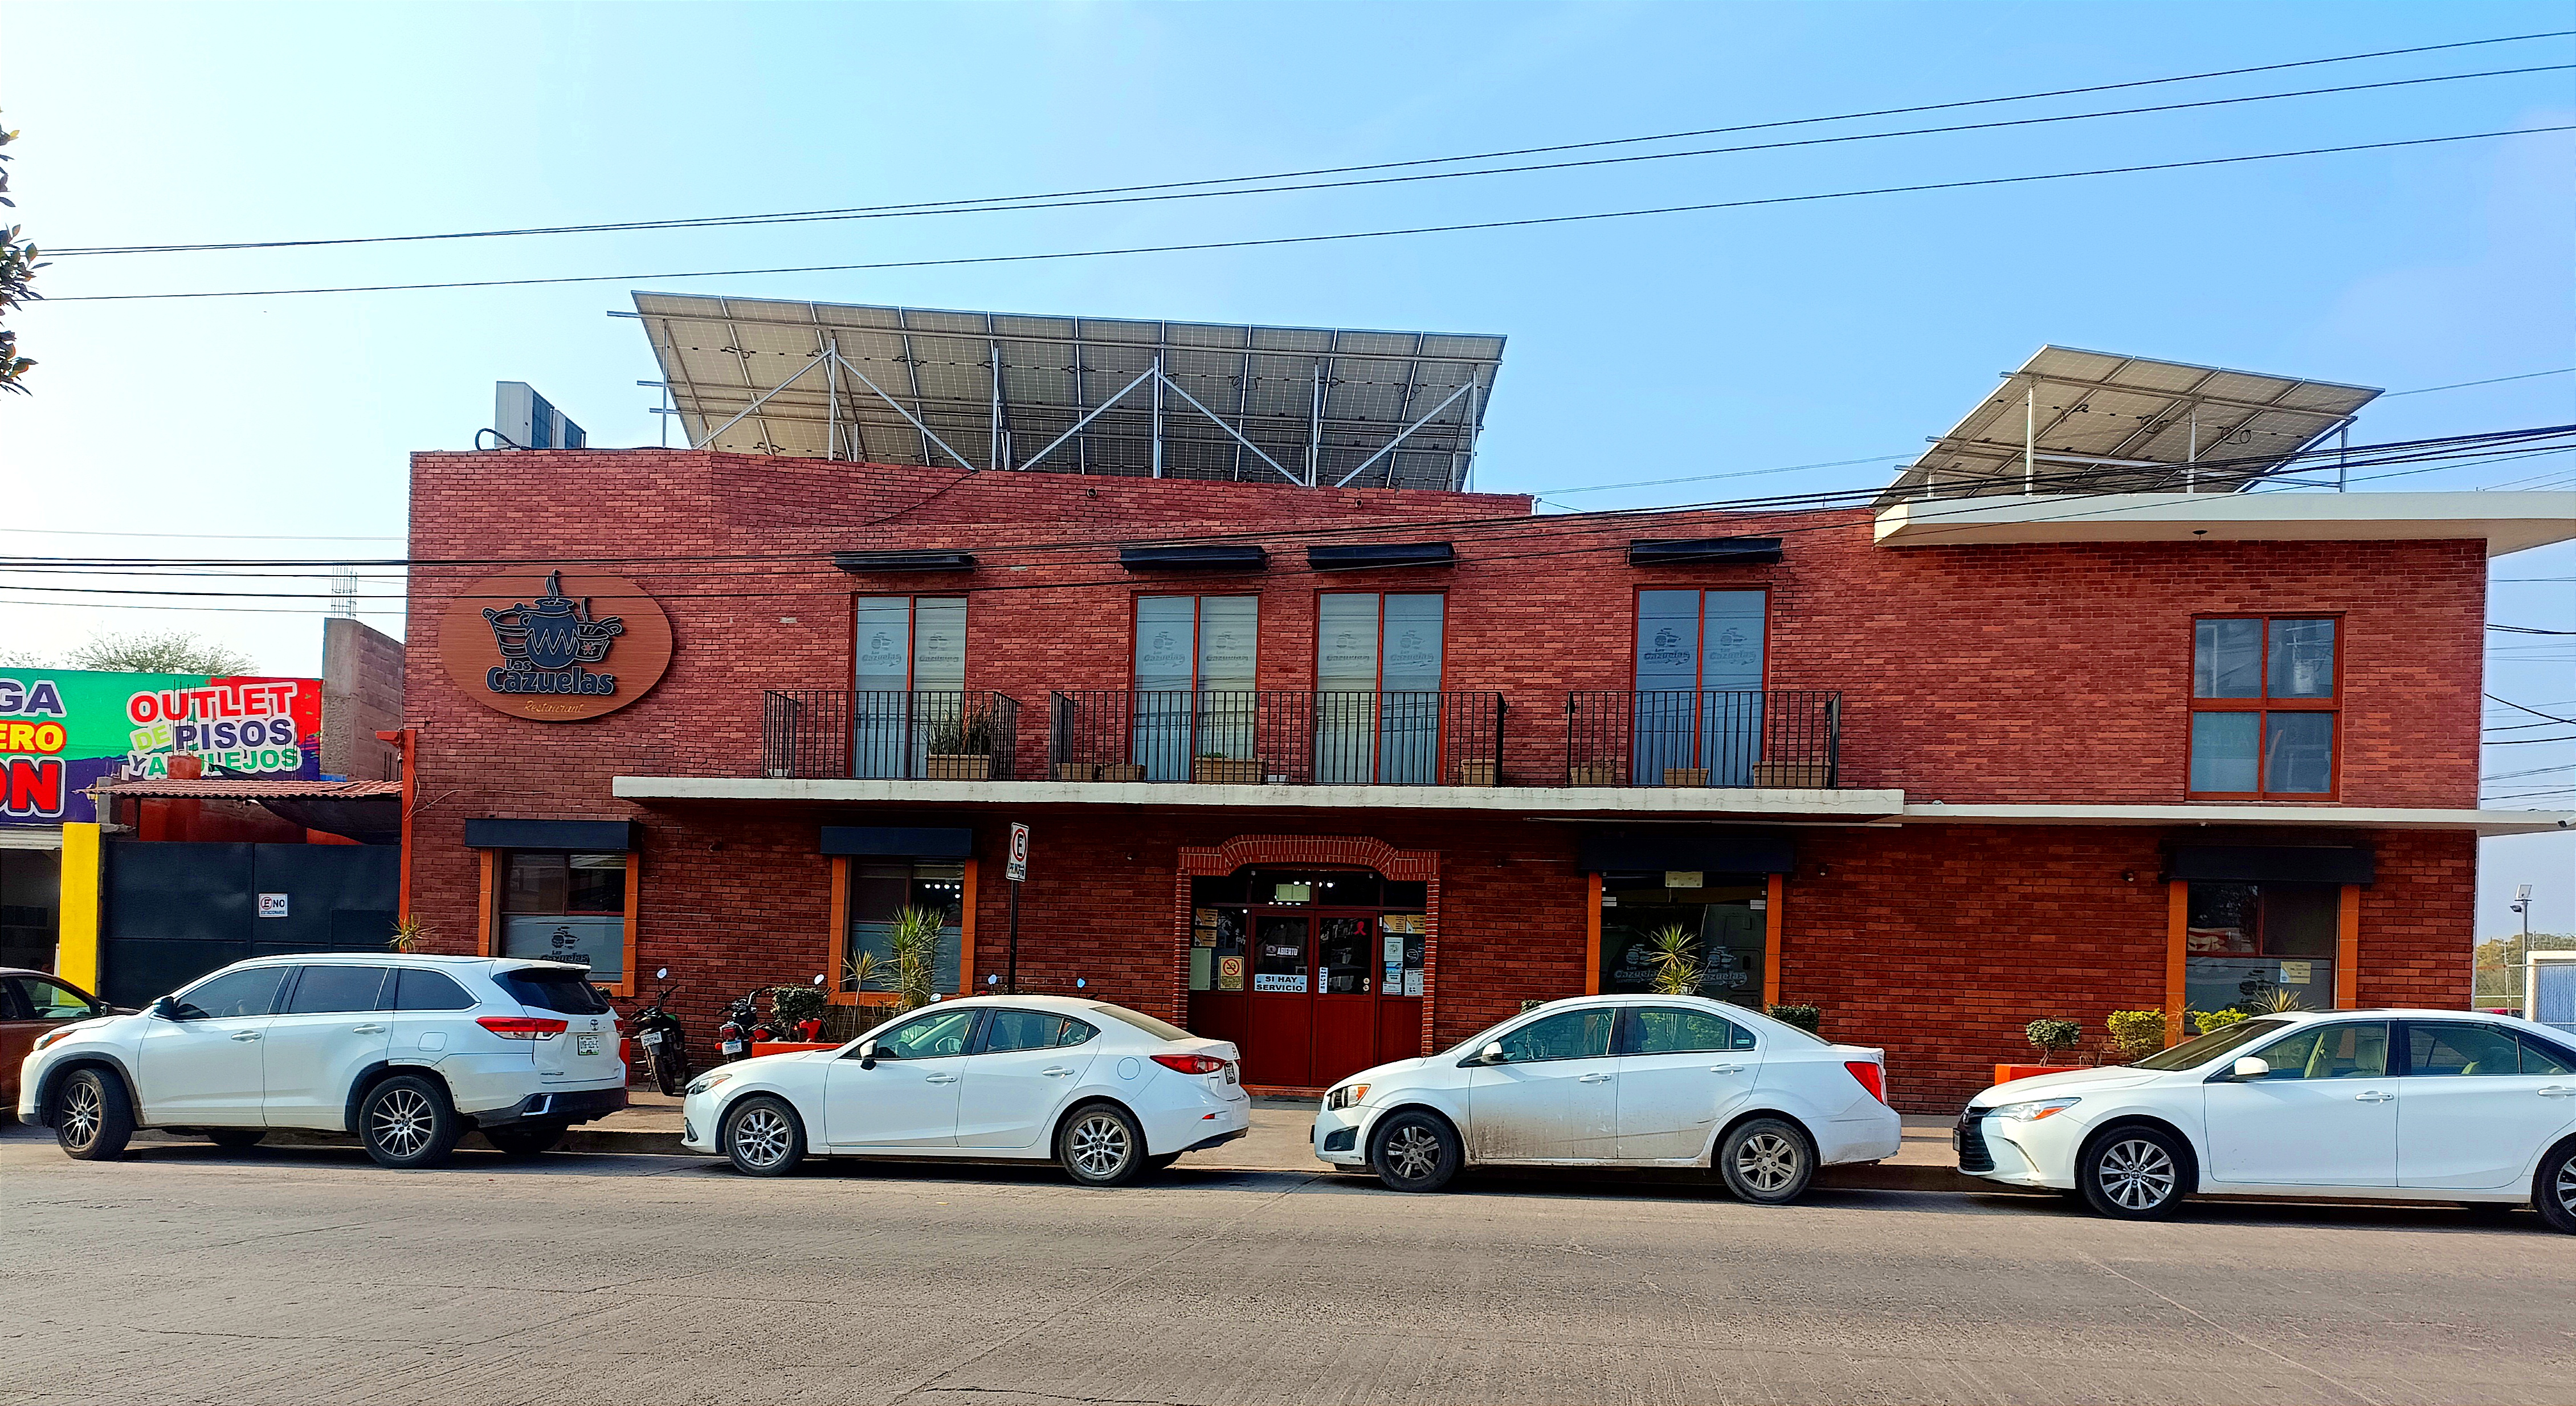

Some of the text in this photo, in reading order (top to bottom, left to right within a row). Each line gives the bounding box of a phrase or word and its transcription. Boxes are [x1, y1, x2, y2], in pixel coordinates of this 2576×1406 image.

[505, 659, 532, 670] Las
[485, 666, 614, 695] Cazuelas
[130, 686, 293, 723] OUTLET
[524, 700, 584, 713] Restaurant
[134, 719, 292, 751] DE PISOS
[131, 755, 147, 772] Y
[0, 762, 59, 811] N
